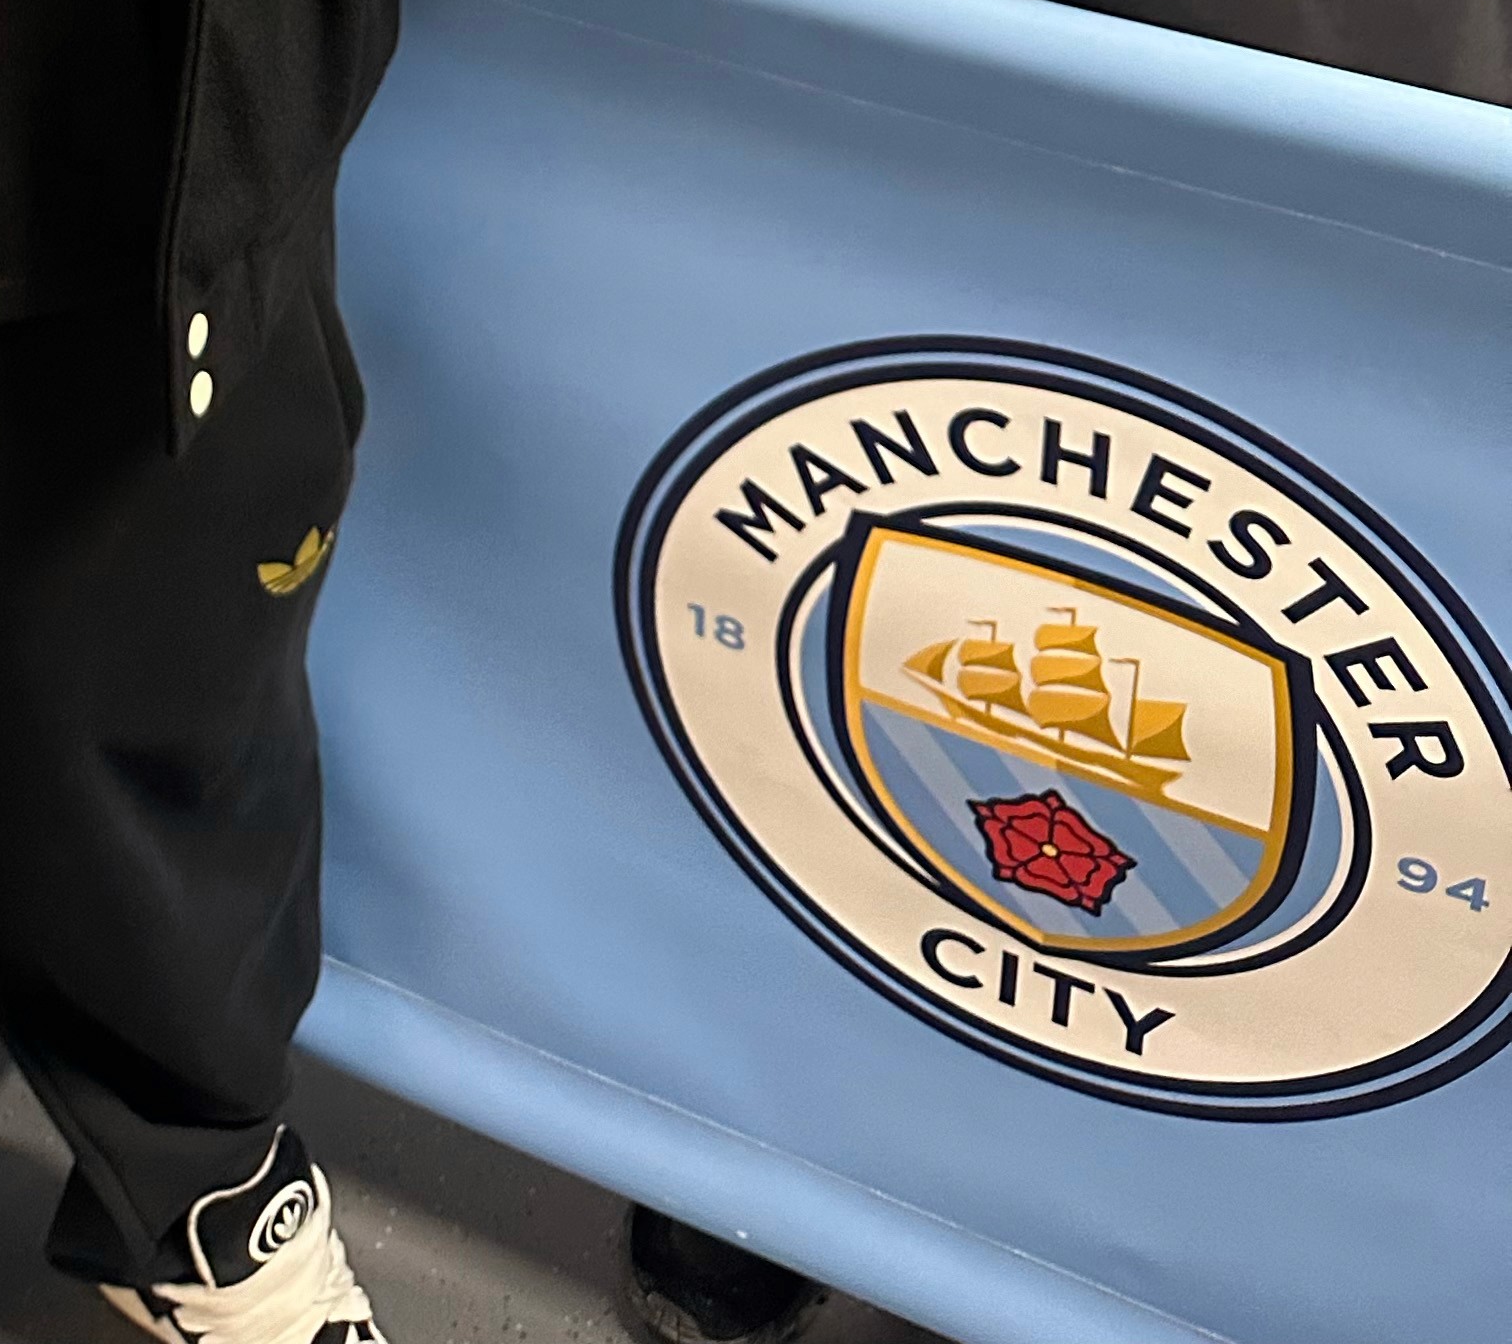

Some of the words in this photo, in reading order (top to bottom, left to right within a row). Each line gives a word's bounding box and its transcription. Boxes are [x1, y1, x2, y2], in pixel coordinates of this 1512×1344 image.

[713, 406, 1466, 782] MANCHESTER
[686, 601, 746, 651] 18
[1395, 856, 1491, 913] 94
[919, 927, 1176, 1057] CITY
